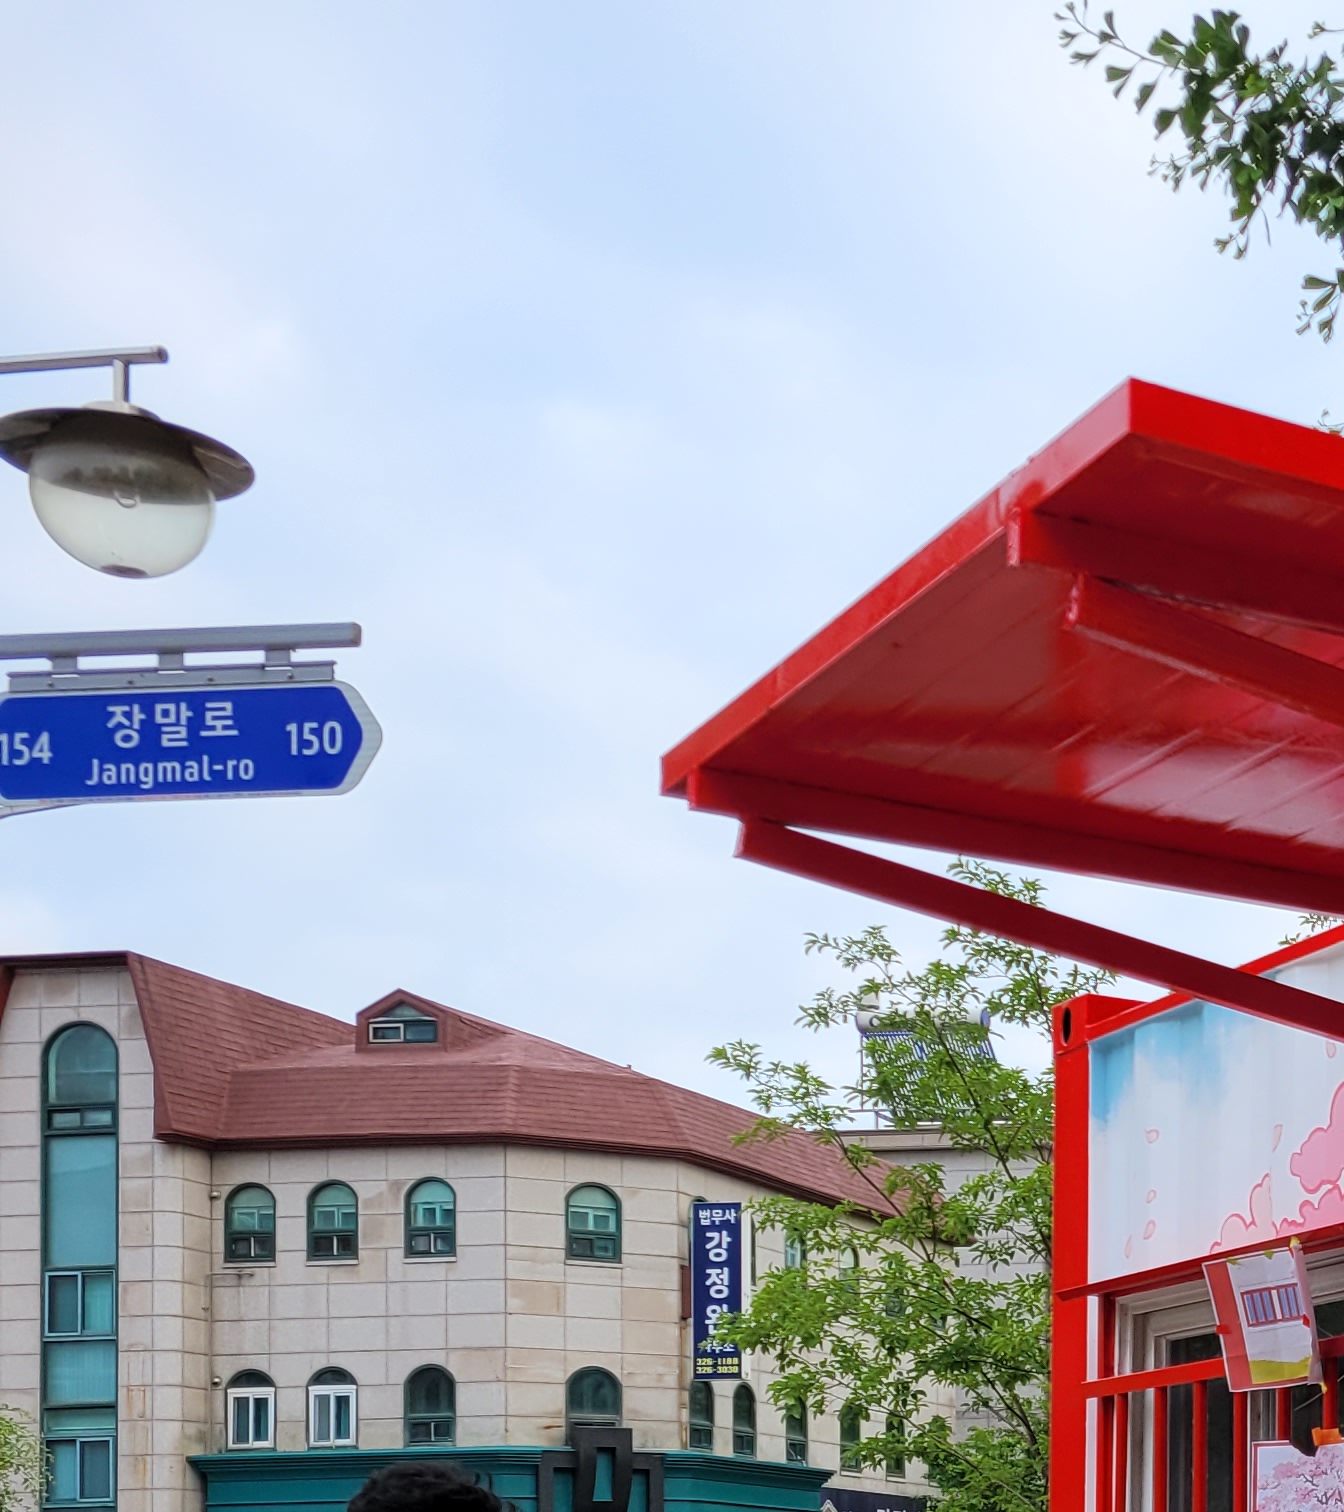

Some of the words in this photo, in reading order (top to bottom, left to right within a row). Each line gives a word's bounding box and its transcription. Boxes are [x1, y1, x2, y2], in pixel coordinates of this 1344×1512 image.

[106, 701, 239, 749] 장말로
[285, 720, 343, 756] 150
[0, 731, 53, 766] 154
[85, 755, 255, 789] Jangmal-ro
[699, 1208, 737, 1226] 법무사
[696, 1357, 739, 1366] 326-1188
[696, 1366, 739, 1374] 326-3030
